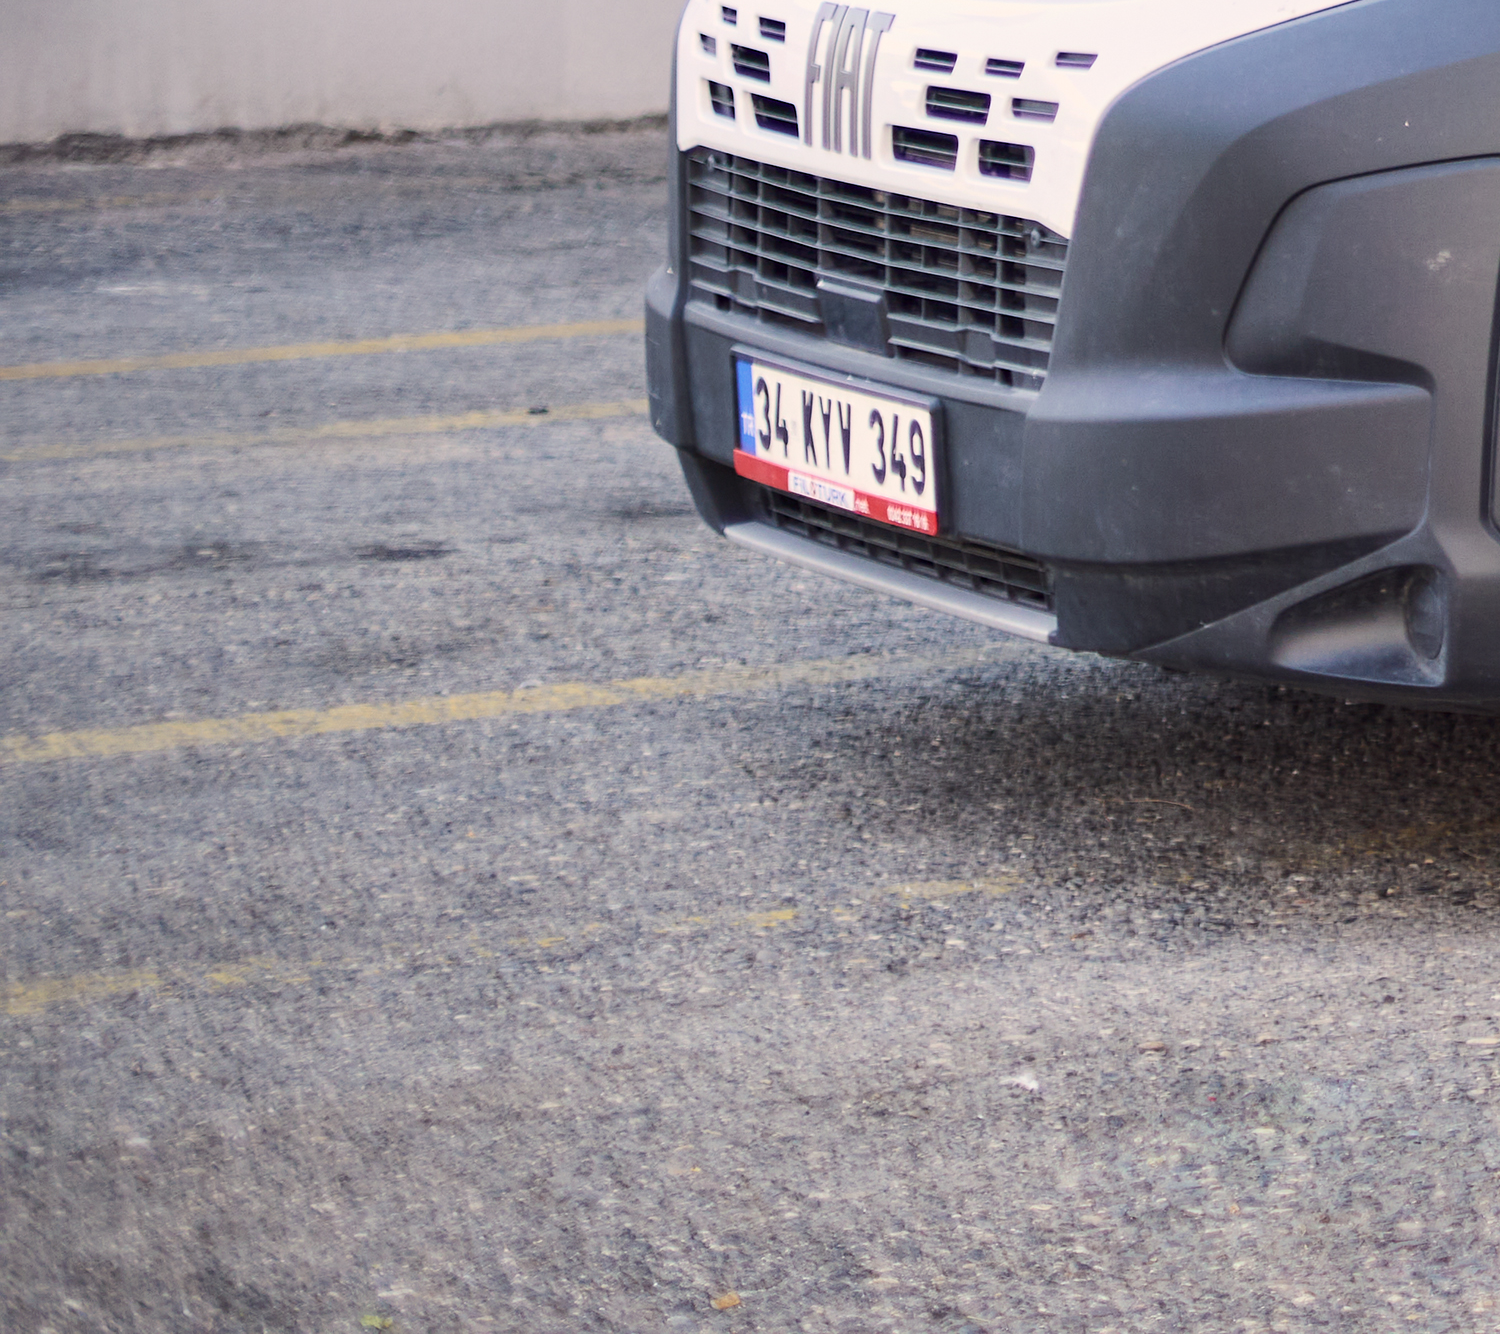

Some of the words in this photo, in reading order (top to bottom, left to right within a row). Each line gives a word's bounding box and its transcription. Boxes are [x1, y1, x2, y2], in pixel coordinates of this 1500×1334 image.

[804, 1, 896, 160] FIAT
[756, 376, 789, 458] 34
[802, 389, 851, 476] KYV
[869, 408, 926, 496] 349
